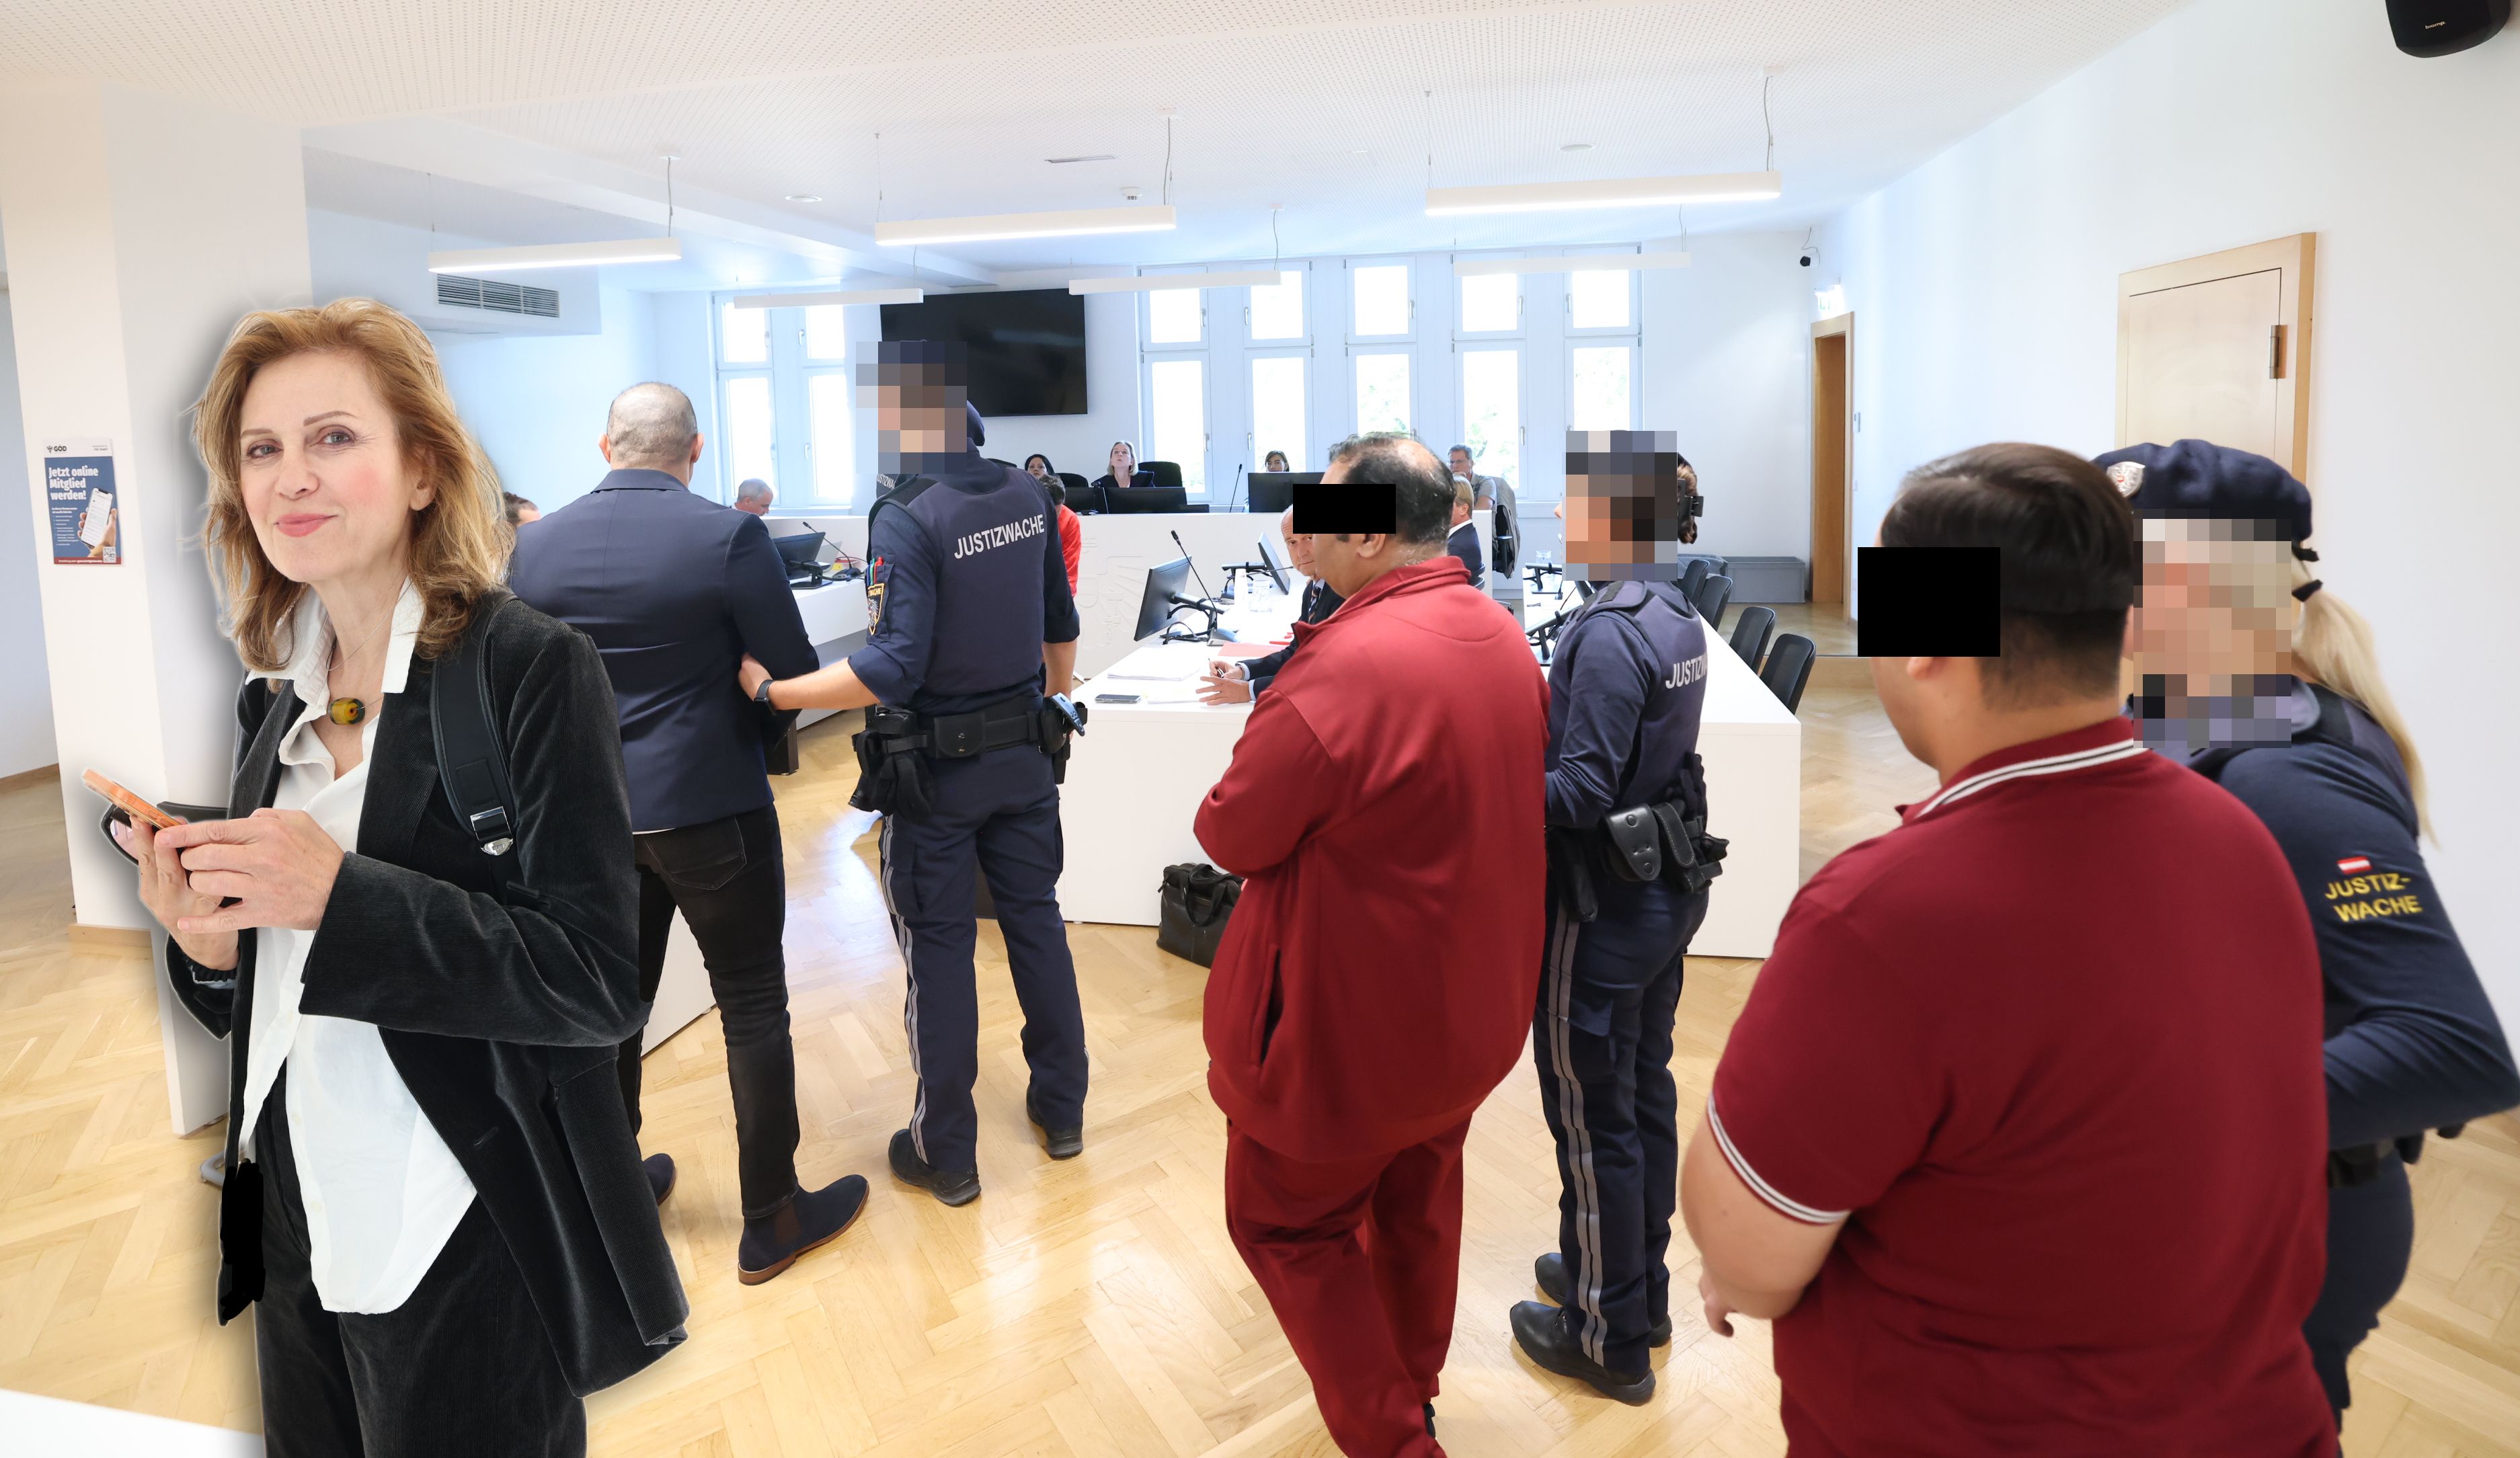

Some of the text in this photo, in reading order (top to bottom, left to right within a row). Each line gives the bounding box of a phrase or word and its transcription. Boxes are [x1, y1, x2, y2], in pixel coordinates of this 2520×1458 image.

[48, 465, 99, 479] Jetzt online
[50, 477, 86, 491] Mitglied
[50, 489, 87, 500] werden!
[954, 514, 1045, 559] JUSTIZWACHE
[2324, 873, 2411, 899] JUSTIZ-
[2334, 895, 2423, 922] WACHE
